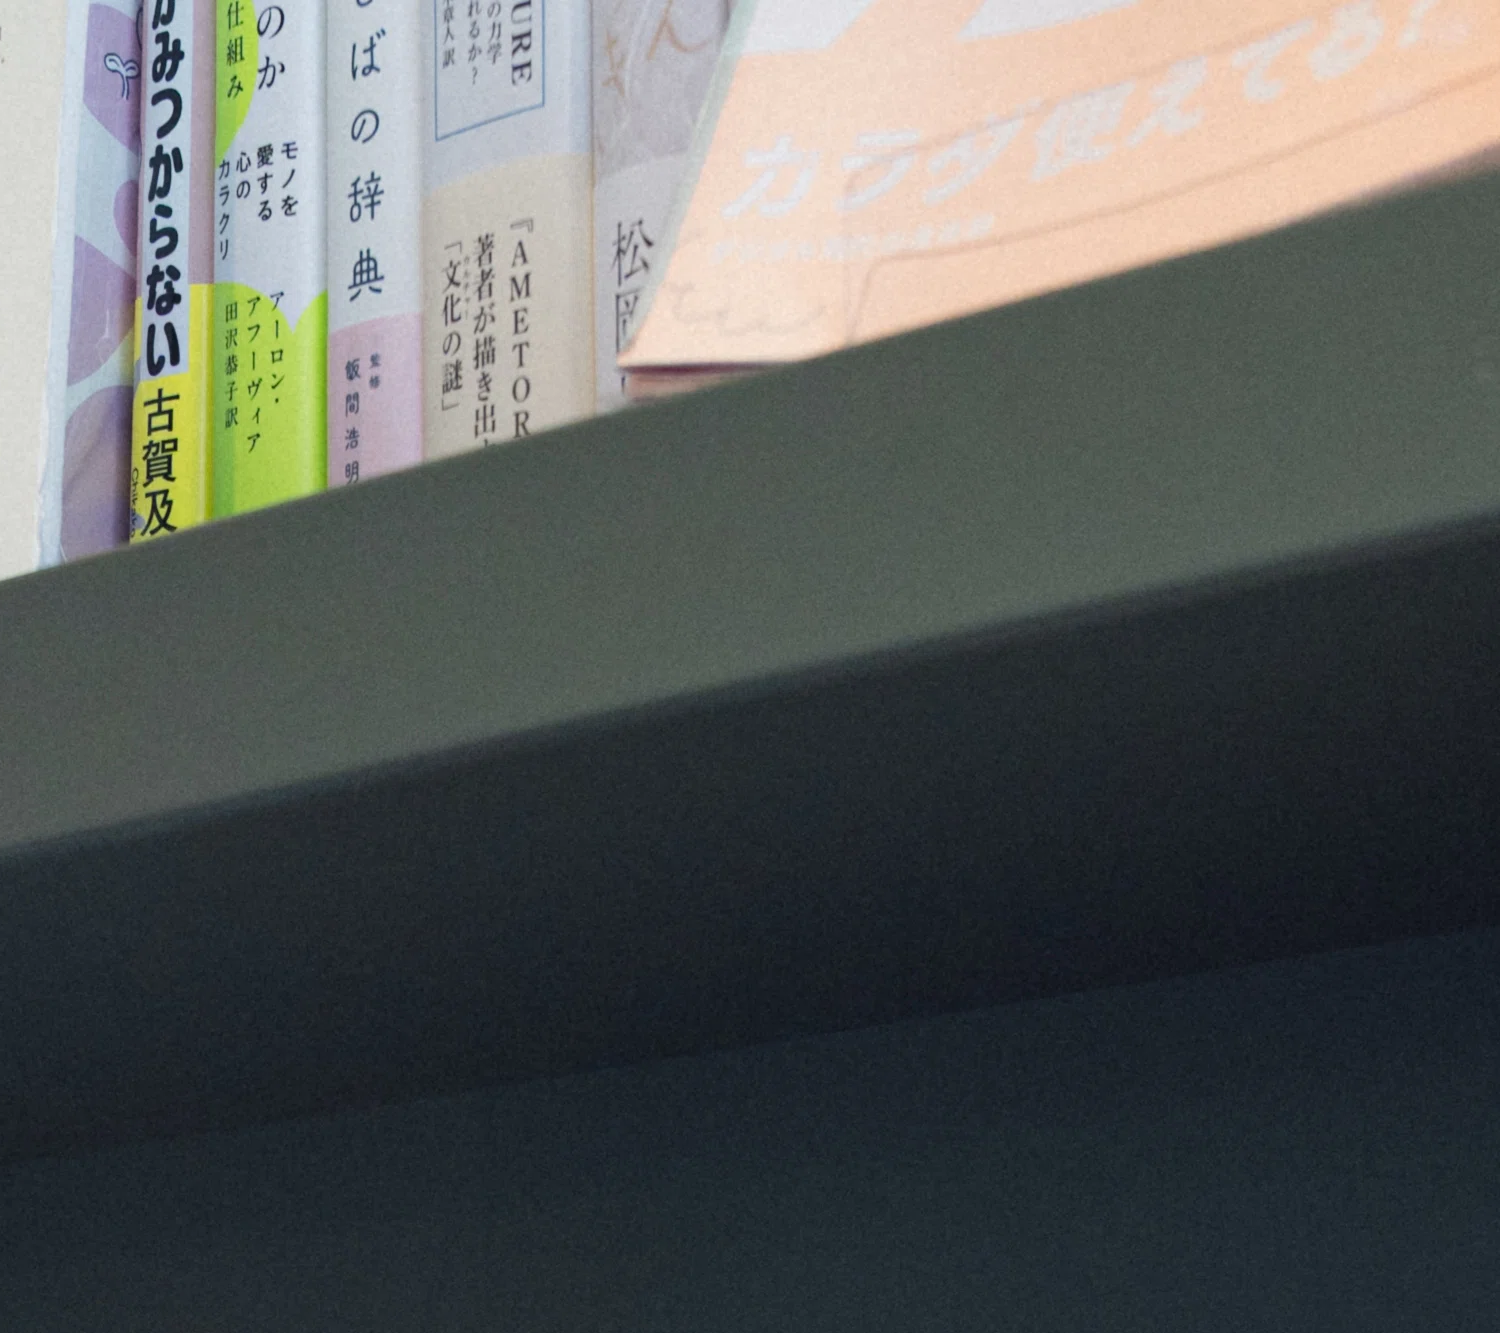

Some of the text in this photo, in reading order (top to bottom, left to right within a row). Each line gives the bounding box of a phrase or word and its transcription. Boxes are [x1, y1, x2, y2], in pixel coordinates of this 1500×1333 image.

[218, 161, 230, 260] カラクリ
[236, 151, 250, 199] 心の
[257, 143, 274, 221] 愛する
[281, 142, 298, 217] モノを
[348, 0, 386, 301] ばの辞典
[225, 302, 238, 429] 田沢恭子訳
[248, 296, 262, 453] アフーヴィア
[442, 240, 462, 410] 「文化の謎」
[473, 234, 496, 449] 著者が描き出
[141, 388, 180, 536] 古賀及
[345, 358, 360, 484] 飯間浩明
